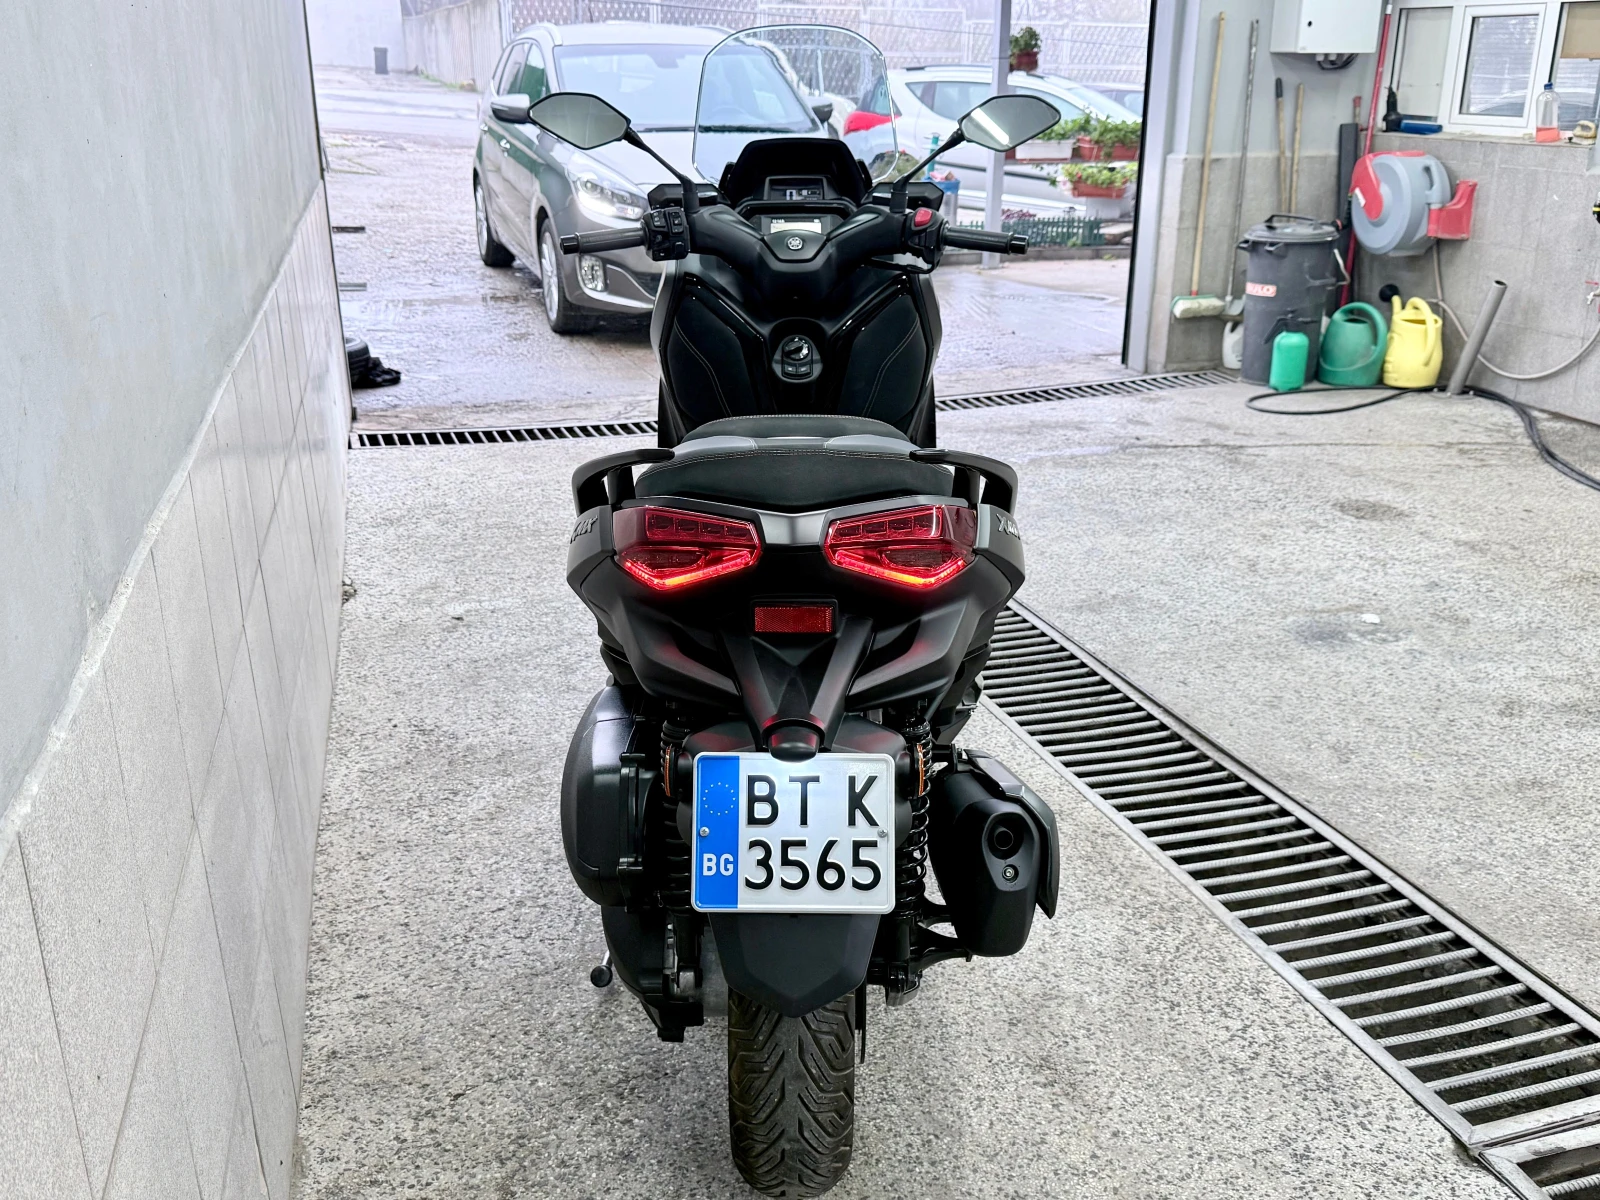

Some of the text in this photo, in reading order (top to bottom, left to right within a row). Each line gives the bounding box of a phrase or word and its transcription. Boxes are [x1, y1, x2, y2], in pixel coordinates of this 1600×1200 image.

[847, 775, 880, 827] K
[702, 853, 734, 876] BG
[745, 838, 882, 891] 3565
